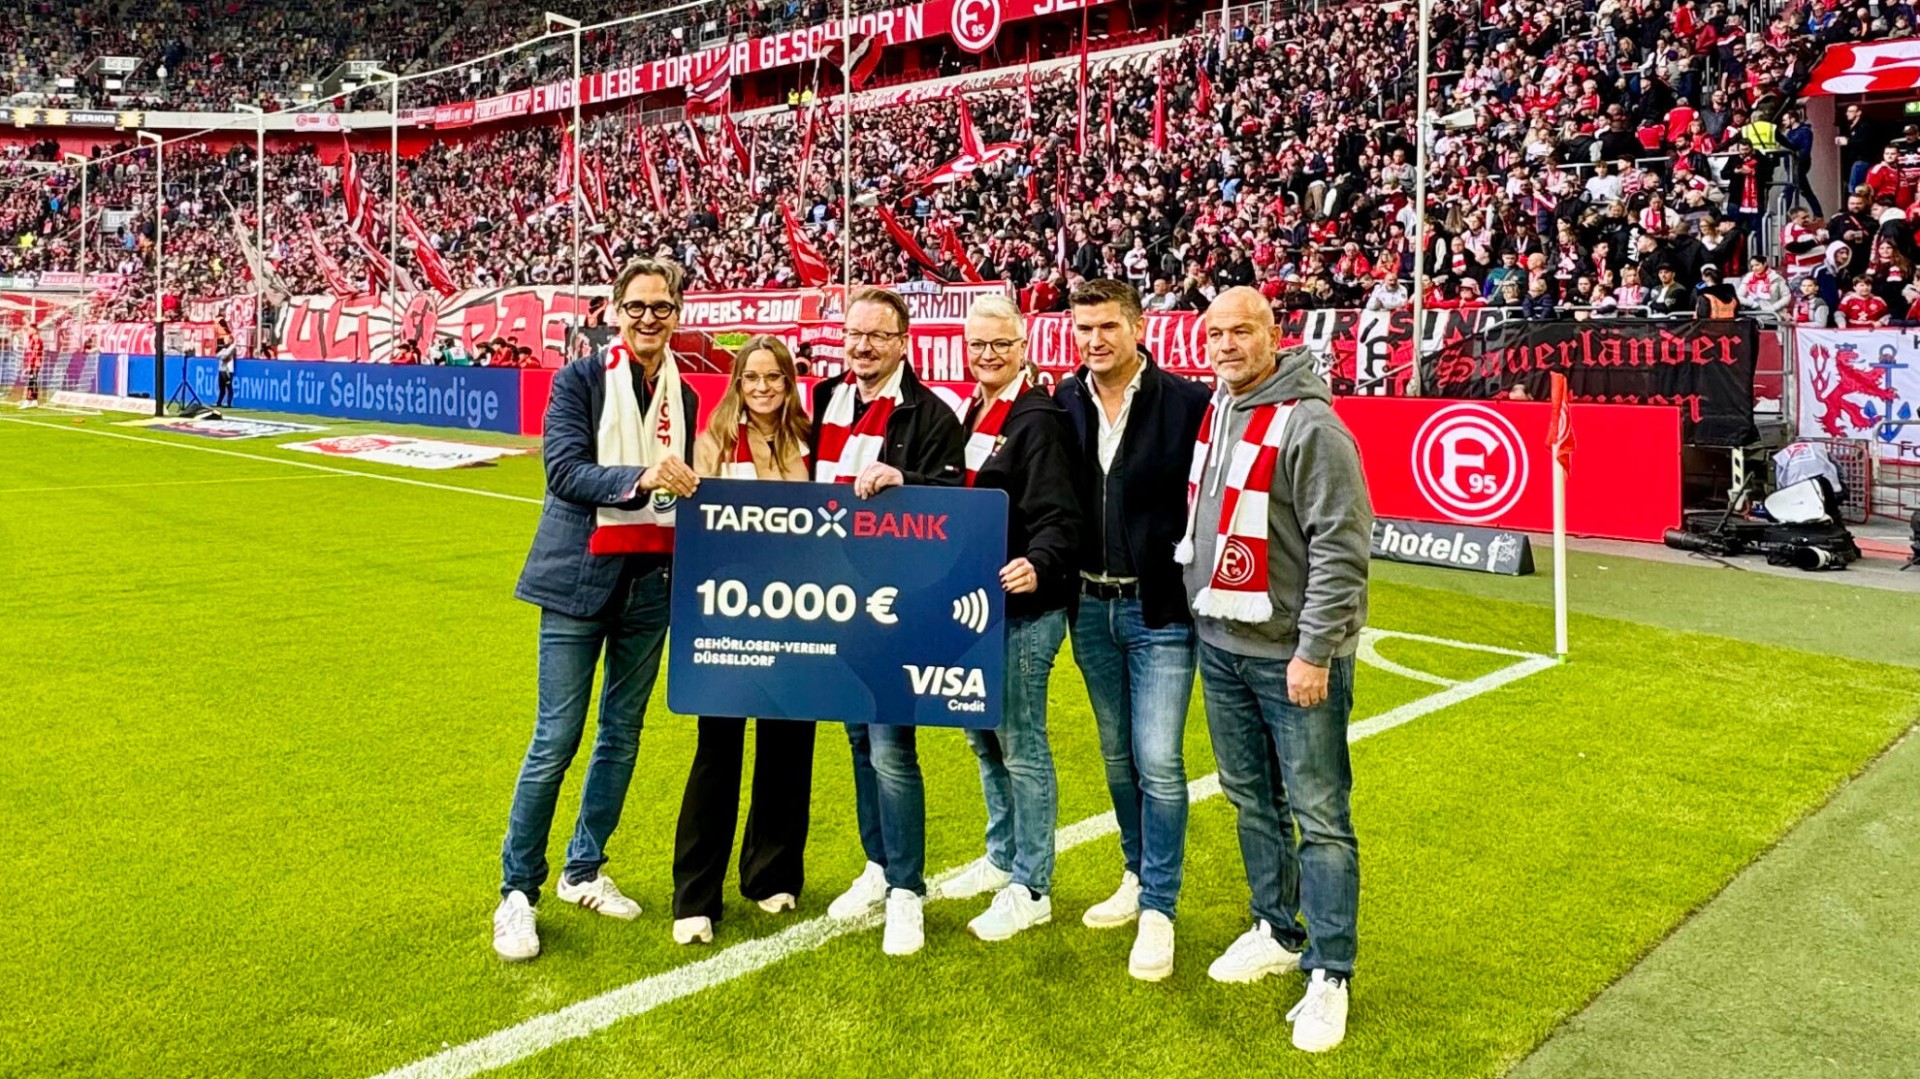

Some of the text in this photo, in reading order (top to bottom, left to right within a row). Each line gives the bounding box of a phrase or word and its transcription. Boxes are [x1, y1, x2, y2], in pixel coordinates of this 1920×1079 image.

[589, 66, 644, 101] LIEBE
[72, 113, 116, 124] MERKUR
[1282, 310, 1358, 340] WIR
[1437, 328, 1742, 388] Sauerländer
[195, 366, 291, 403] Rüenwind
[296, 369, 326, 408] für
[330, 371, 499, 428] Selbstständige
[657, 396, 672, 448] ORF
[700, 503, 949, 540] TARGO BANK
[1380, 523, 1481, 564] hotels
[696, 579, 899, 625] 10.000 €
[693, 636, 837, 655] GEHÖRLOSEN-VEREINE
[693, 651, 776, 667] DÜSSELDORF
[902, 664, 986, 698] VISA
[947, 699, 985, 713] Credit
